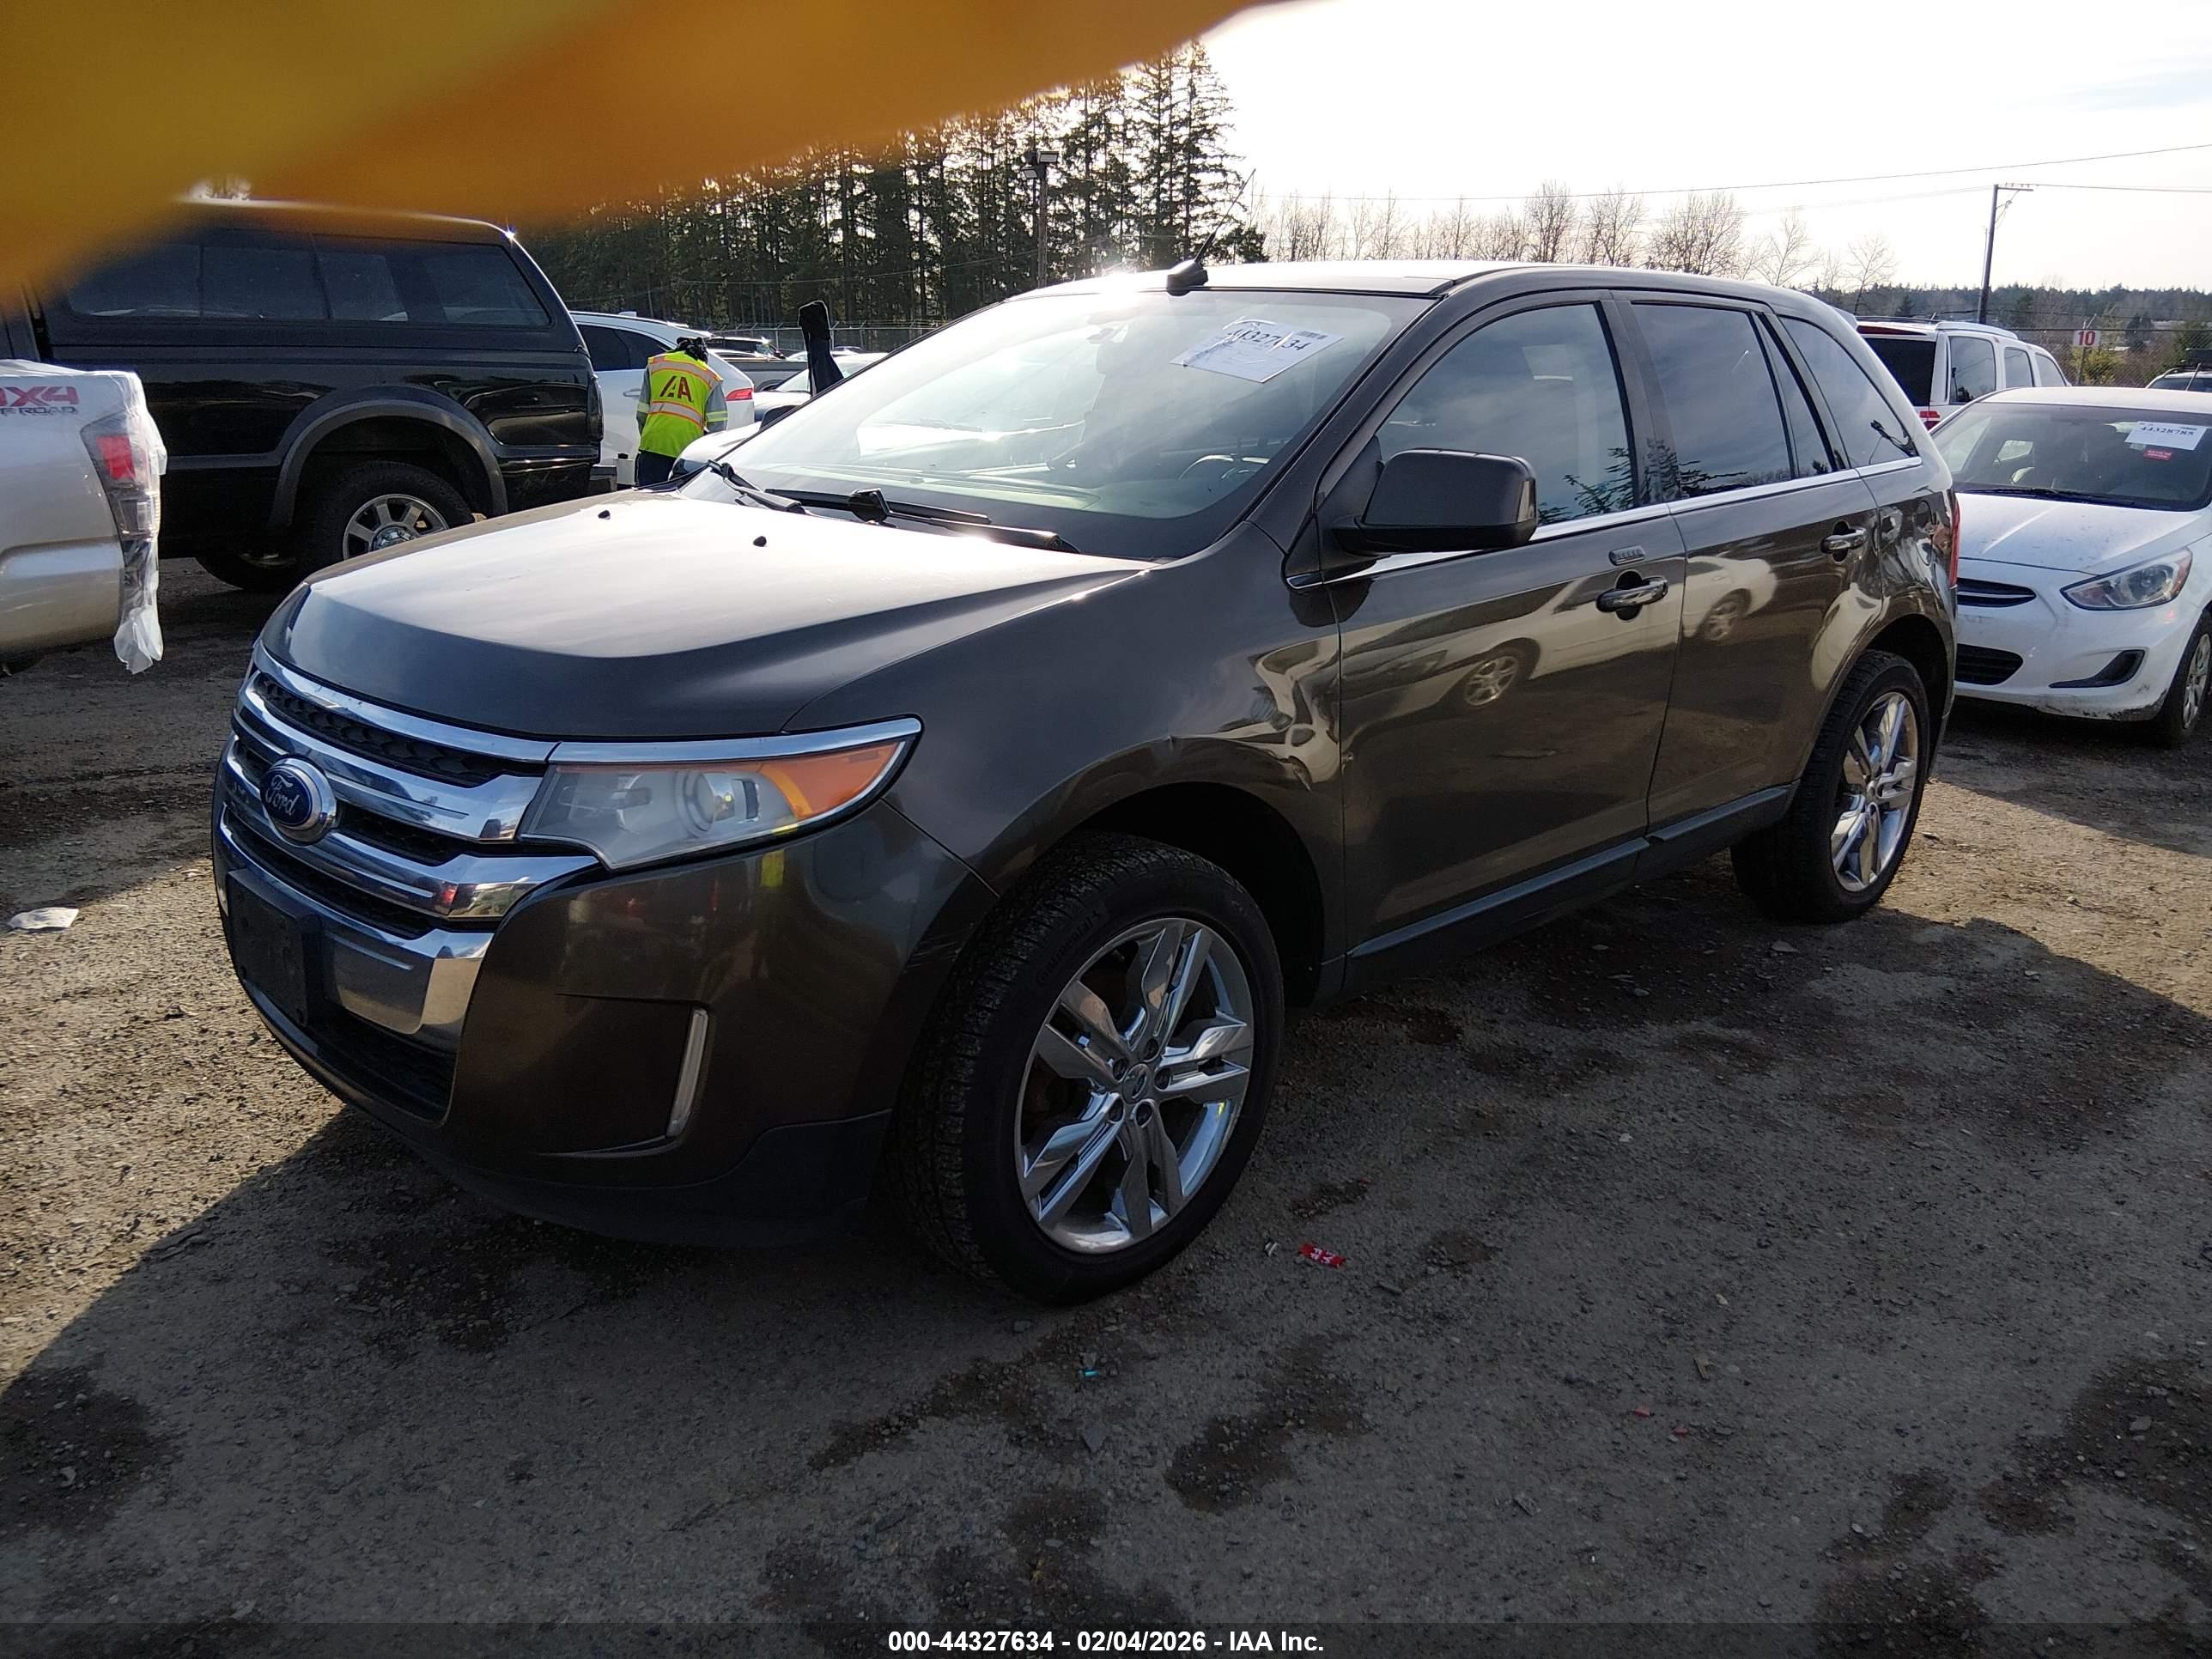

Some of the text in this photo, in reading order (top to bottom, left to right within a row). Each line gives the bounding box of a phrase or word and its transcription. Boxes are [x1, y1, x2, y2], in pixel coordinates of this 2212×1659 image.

[2078, 331, 2095, 346] 10
[0, 386, 80, 407] X4
[264, 775, 301, 817] Ford
